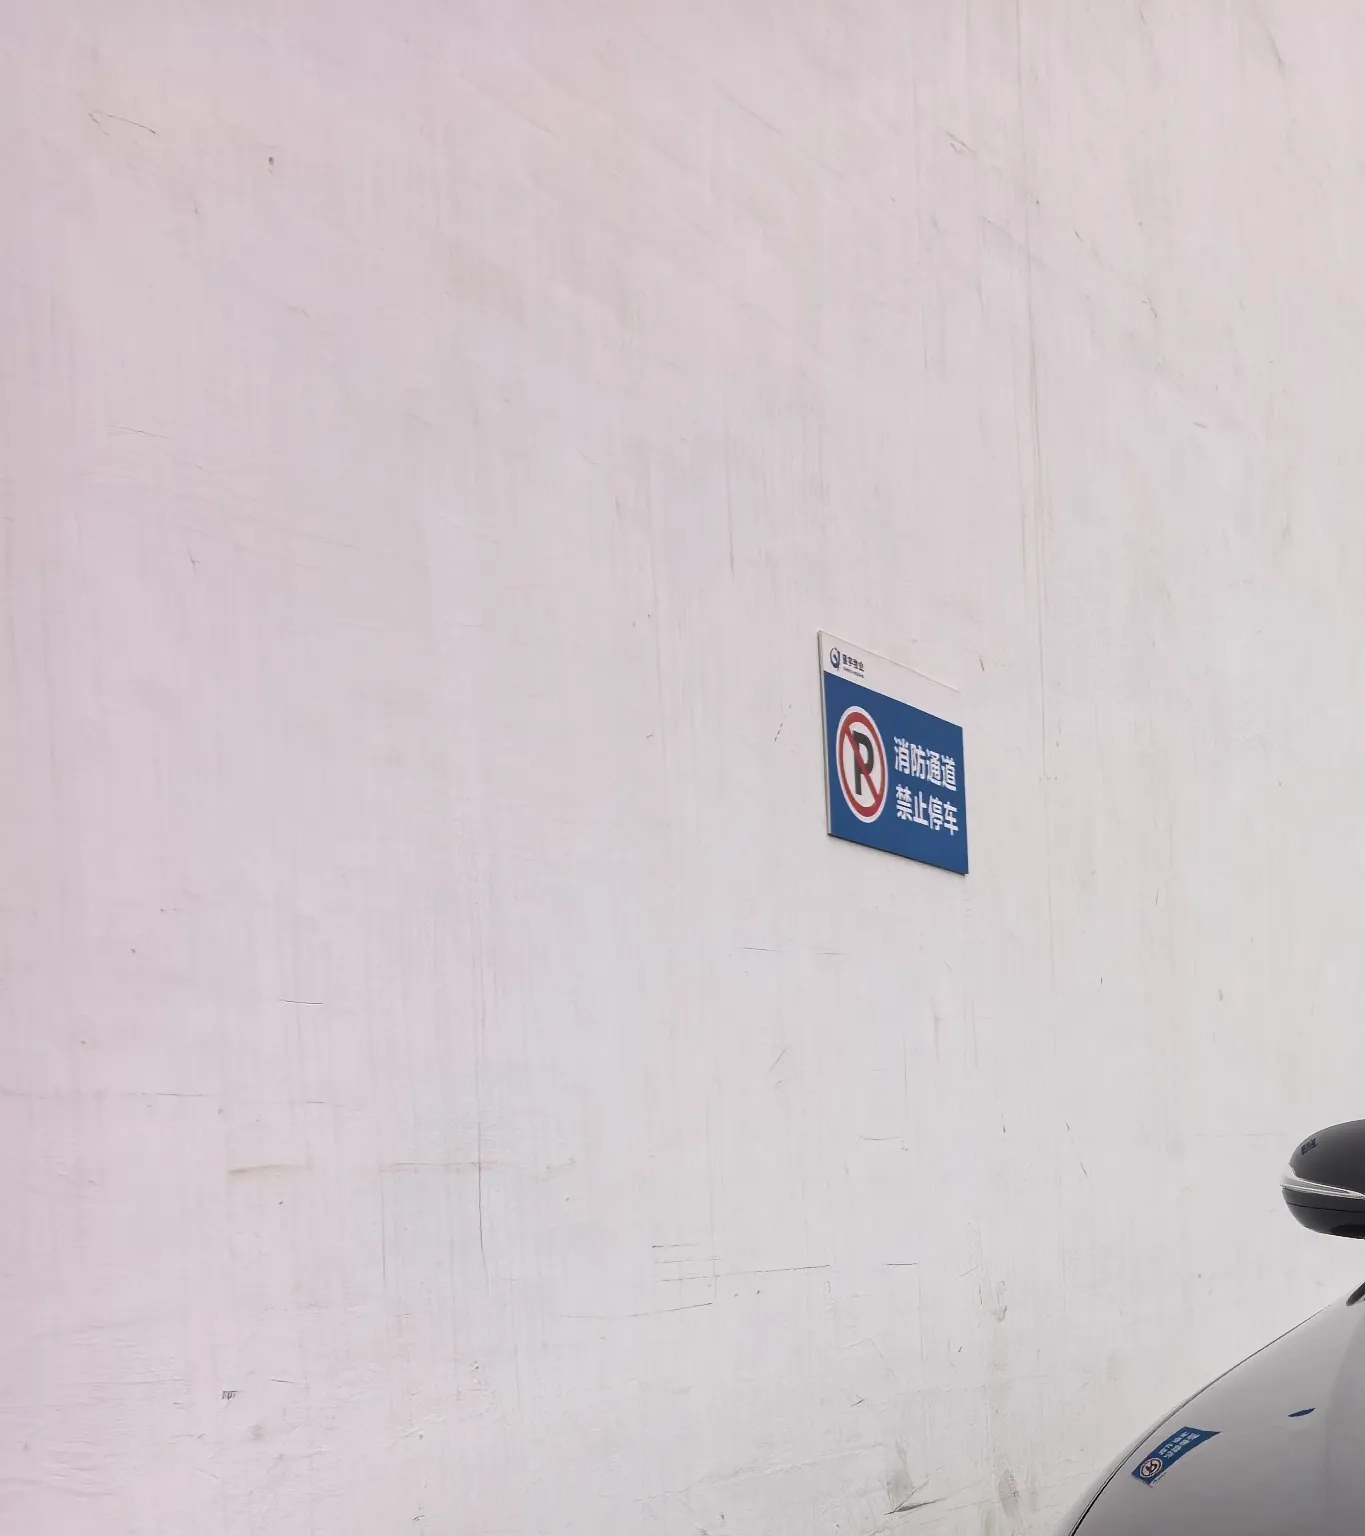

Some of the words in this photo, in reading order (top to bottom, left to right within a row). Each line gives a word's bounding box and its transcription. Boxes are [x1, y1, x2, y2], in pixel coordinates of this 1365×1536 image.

[894, 737, 957, 791] 消防通道
[896, 784, 959, 835] 禁止停车
